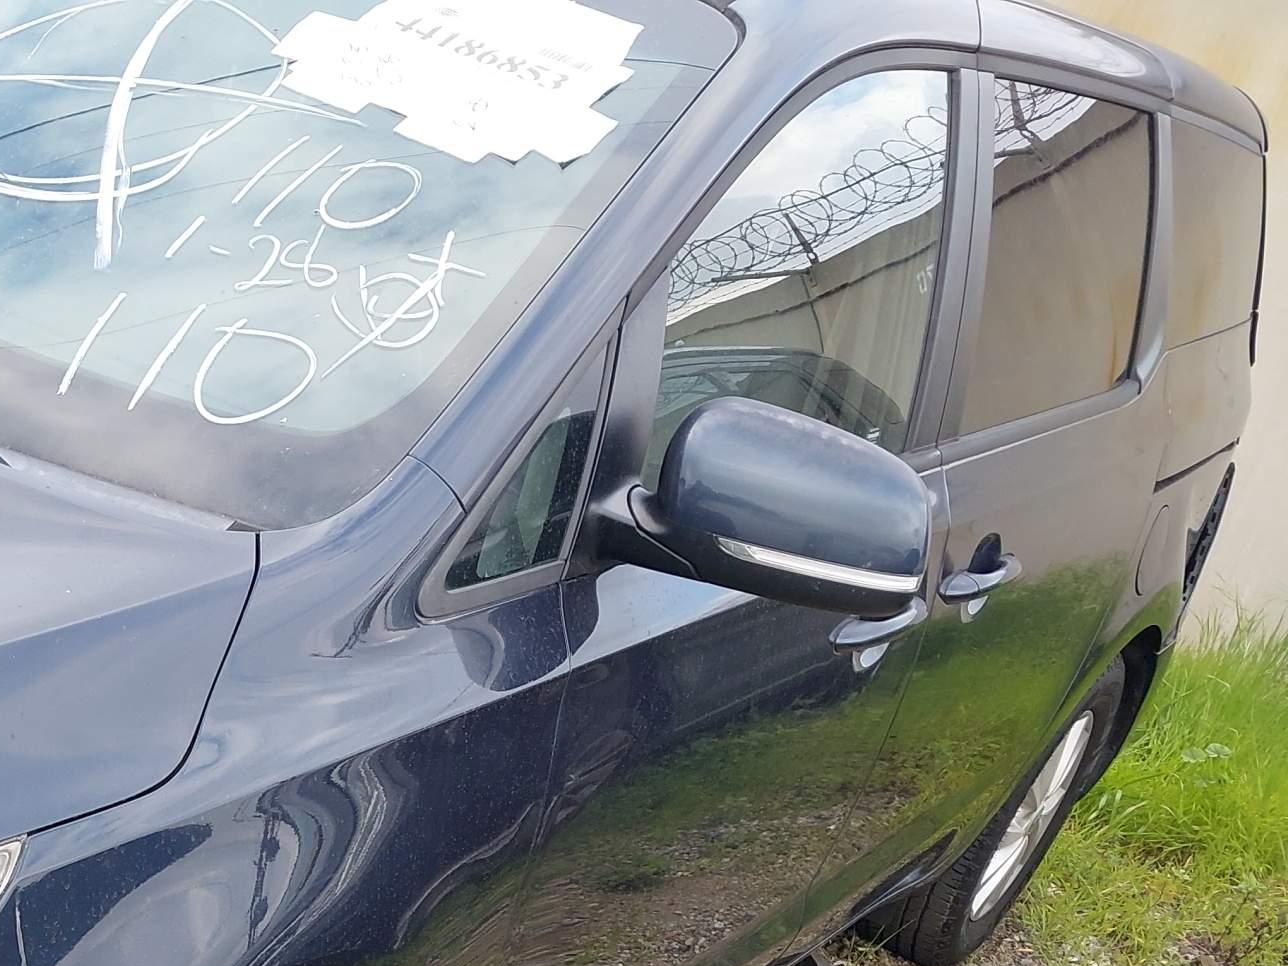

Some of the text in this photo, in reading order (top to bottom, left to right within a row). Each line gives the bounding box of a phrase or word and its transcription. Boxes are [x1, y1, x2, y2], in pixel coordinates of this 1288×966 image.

[395, 16, 570, 90] 44186853
[231, 135, 422, 229] 110
[57, 292, 316, 424] 110
